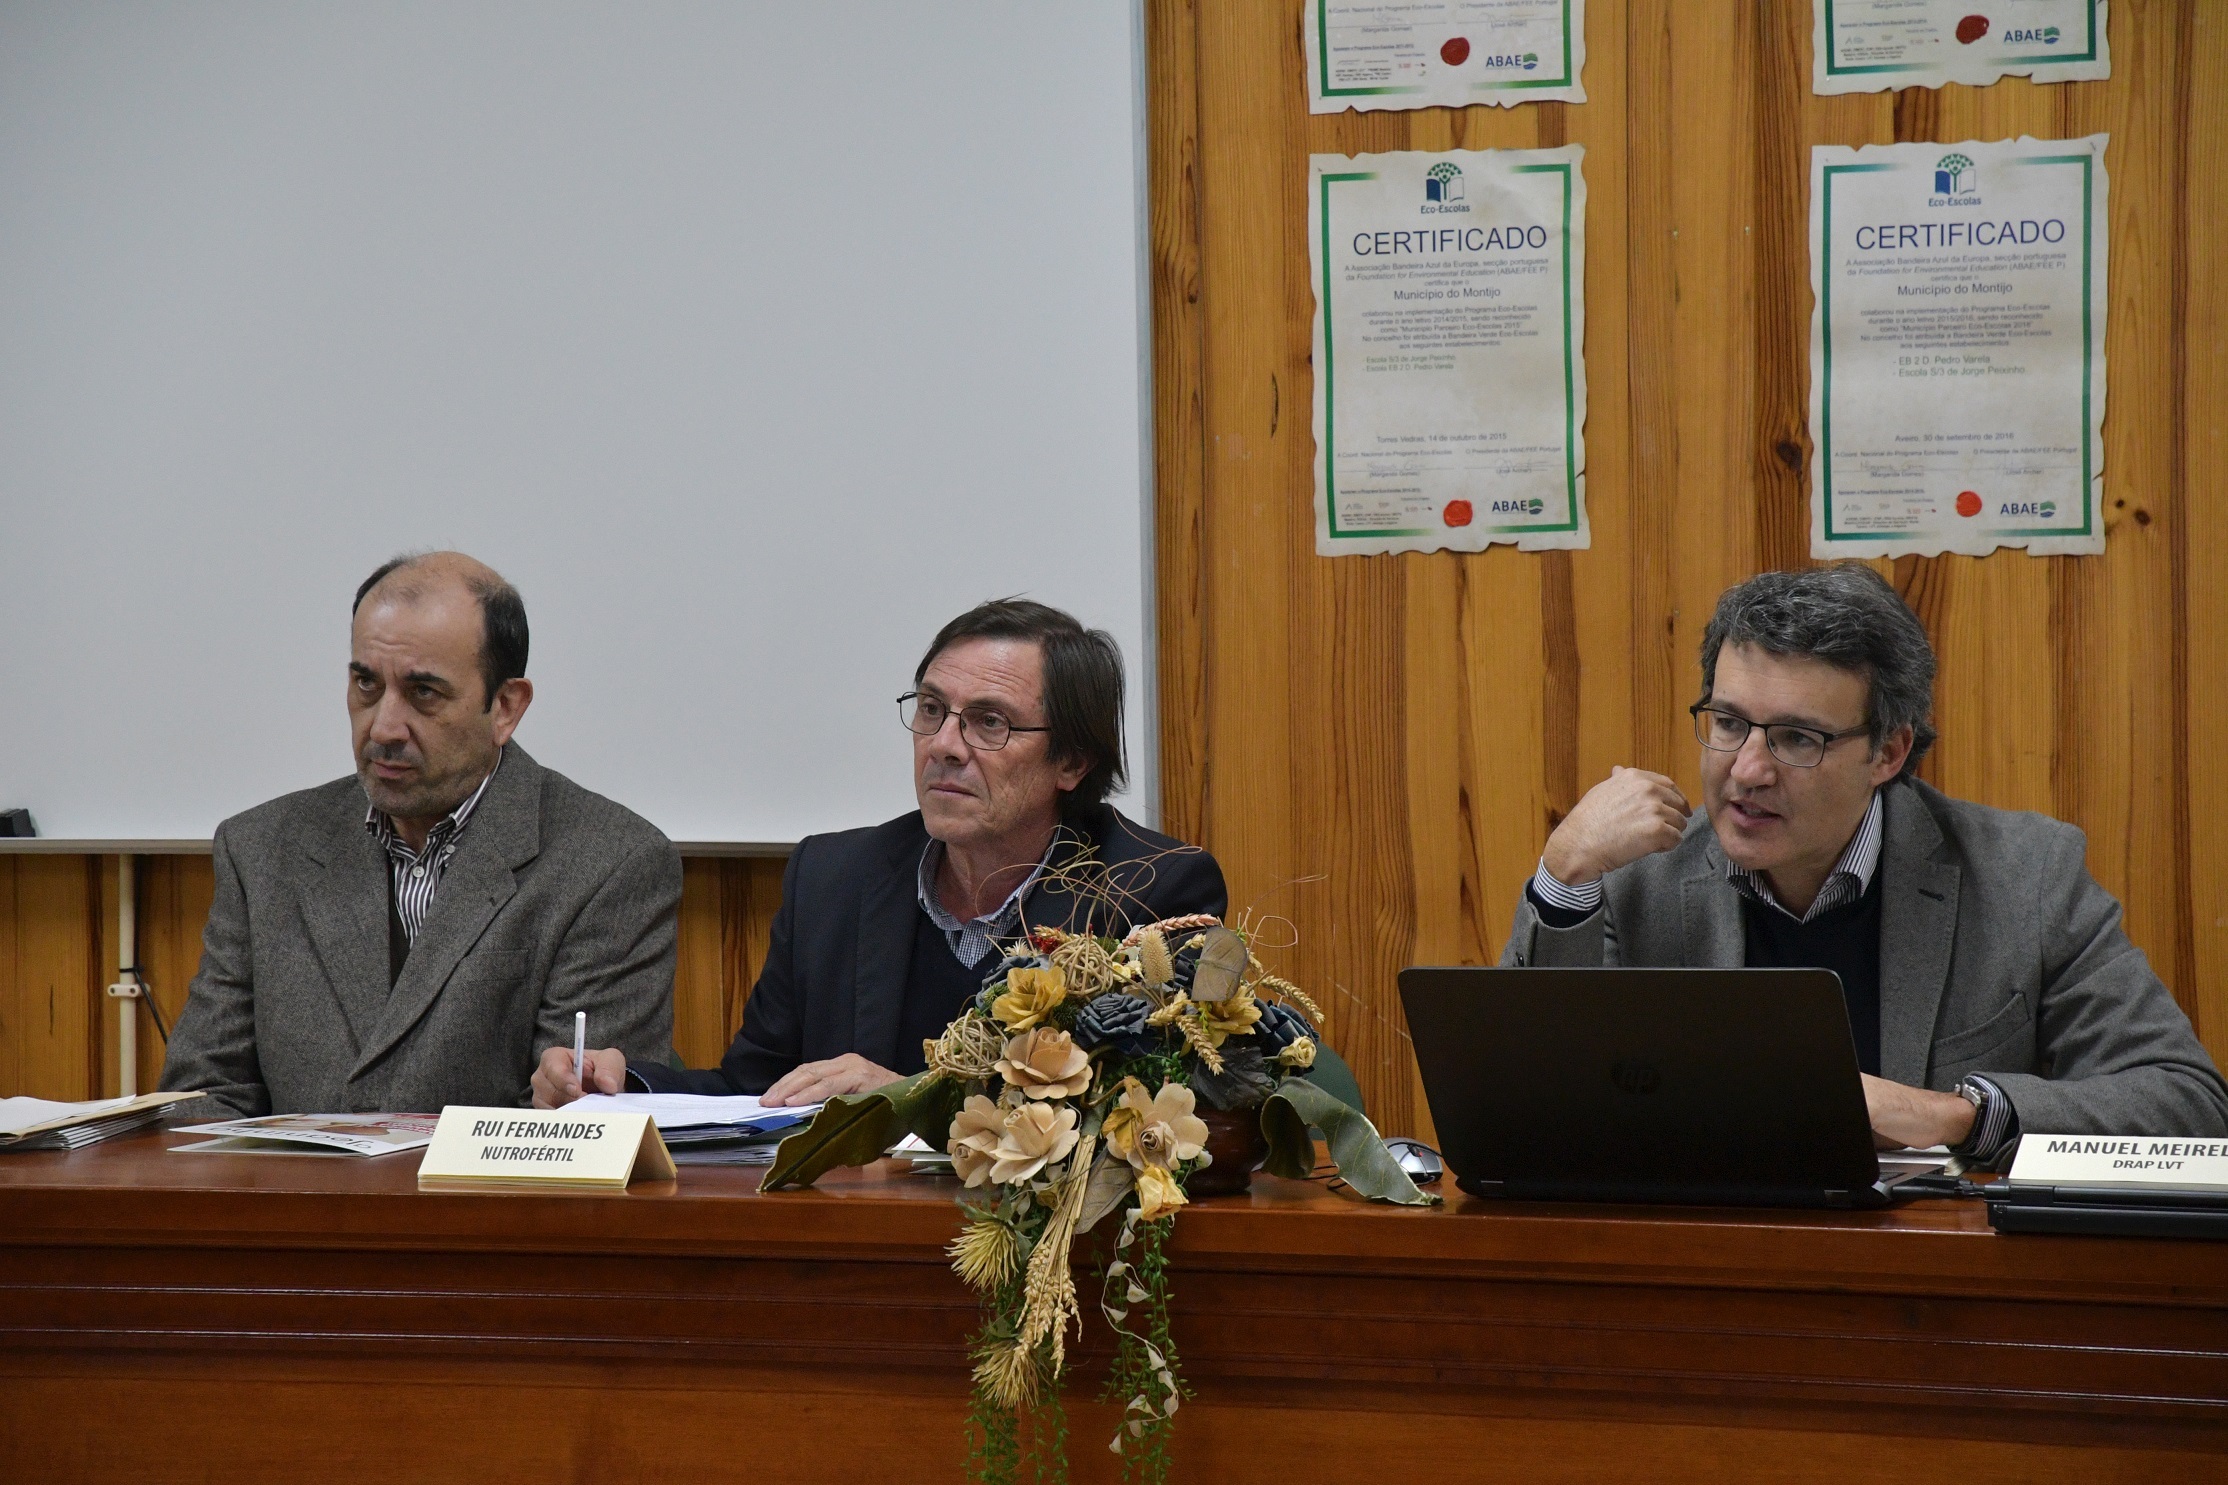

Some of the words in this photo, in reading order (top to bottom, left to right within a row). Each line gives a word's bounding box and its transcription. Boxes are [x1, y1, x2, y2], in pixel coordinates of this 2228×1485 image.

[2003, 29, 2042, 42] ABAE
[1486, 55, 1521, 67] ABAE
[1928, 196, 1981, 207] Eco-Escolas
[1420, 203, 1470, 214] Eco-Escolas
[1353, 225, 1546, 255] CERTIFICADO
[1856, 218, 2064, 250] CERTIFICADO
[1394, 288, 1443, 301] Município
[1447, 288, 1459, 298] do
[1463, 286, 1500, 299] Montijo
[1897, 284, 1950, 297] Município
[1954, 284, 1967, 293] do
[1972, 282, 2012, 295] Montijo
[1898, 357, 1911, 365] EB
[1934, 355, 1960, 363] Pedro
[1962, 354, 1990, 363] Varela
[1898, 368, 1927, 377] Escola
[1947, 367, 1957, 375] de
[1960, 366, 1984, 376] Jorge
[1987, 365, 2024, 374] Peixinho
[1492, 500, 1526, 512] ABAE
[2000, 502, 2037, 514] ABAE
[471, 1120, 504, 1136] RUI
[505, 1122, 605, 1140] FERNANDES
[481, 1145, 574, 1162] NUTROFÉRTIL
[2047, 1140, 2141, 1155] MANUEL
[2148, 1143, 2228, 1157] MEIREL
[2113, 1160, 2155, 1169] DRAP
[2157, 1161, 2184, 1170] LVT
